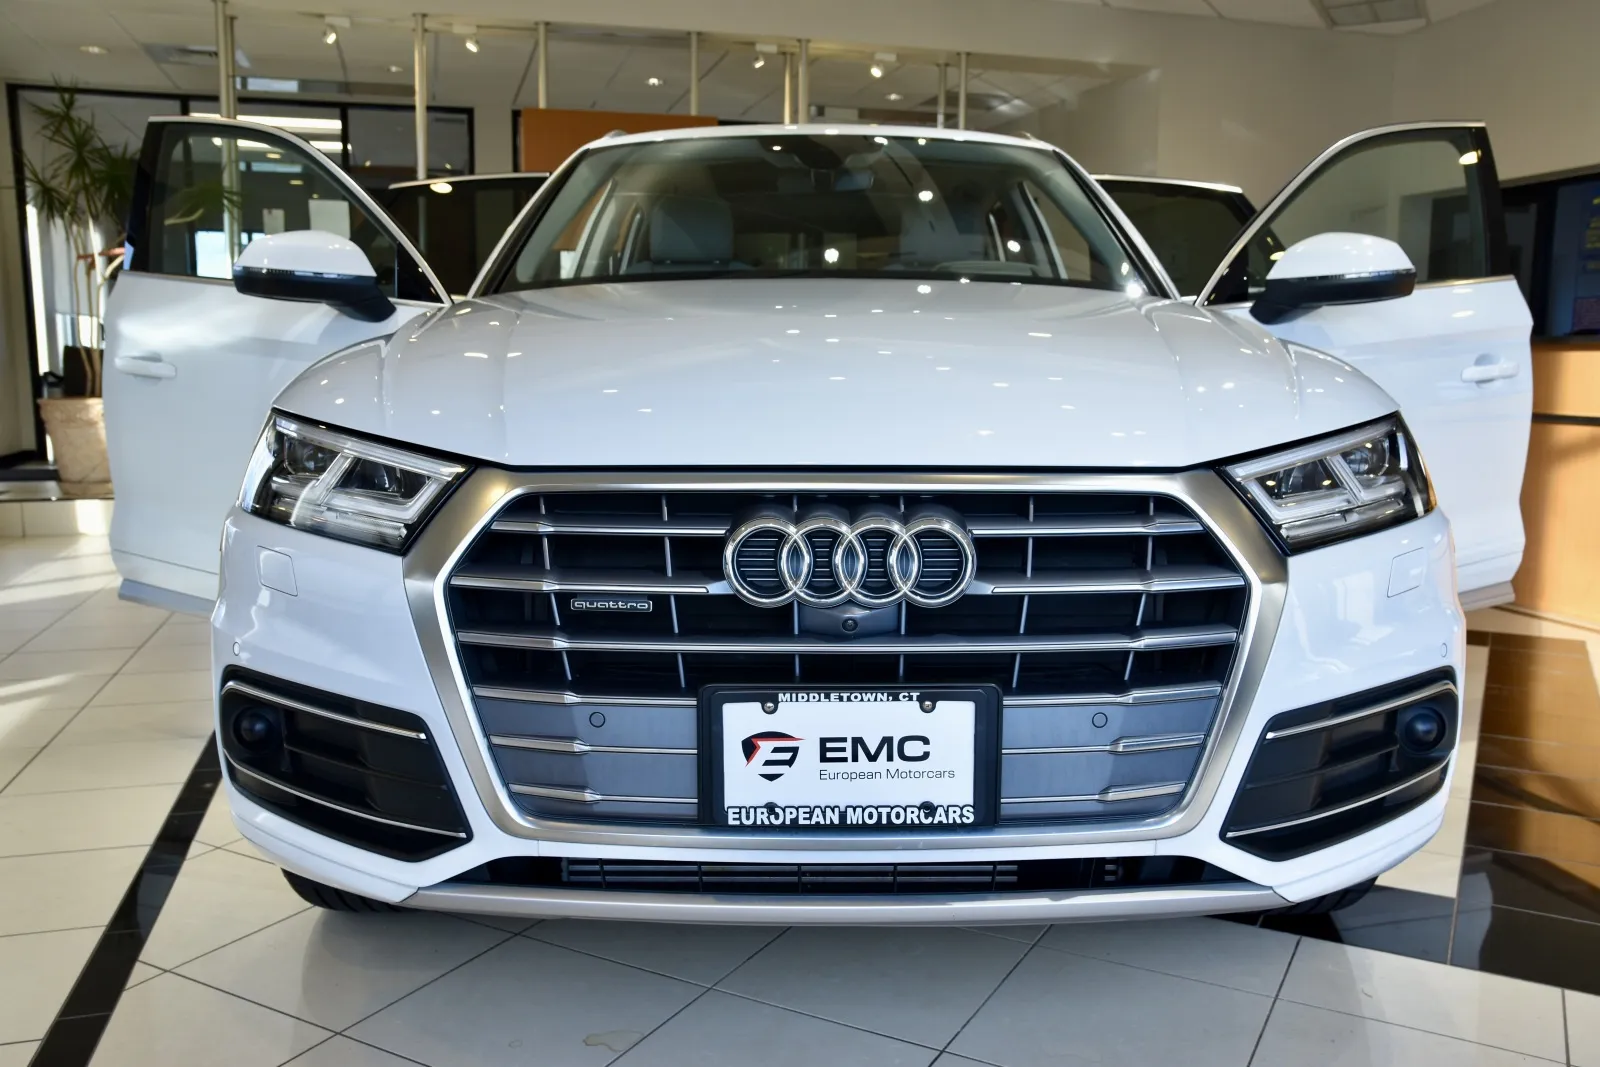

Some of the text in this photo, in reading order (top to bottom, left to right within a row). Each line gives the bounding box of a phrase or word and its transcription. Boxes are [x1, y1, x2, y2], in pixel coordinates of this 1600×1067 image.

[574, 601, 649, 610] quattro
[778, 692, 920, 703] MIDDLETOWN, CT
[819, 735, 931, 763] EMC
[819, 768, 955, 782] European Motorcars
[727, 806, 975, 825] EUROPEAN MOTORCARS
